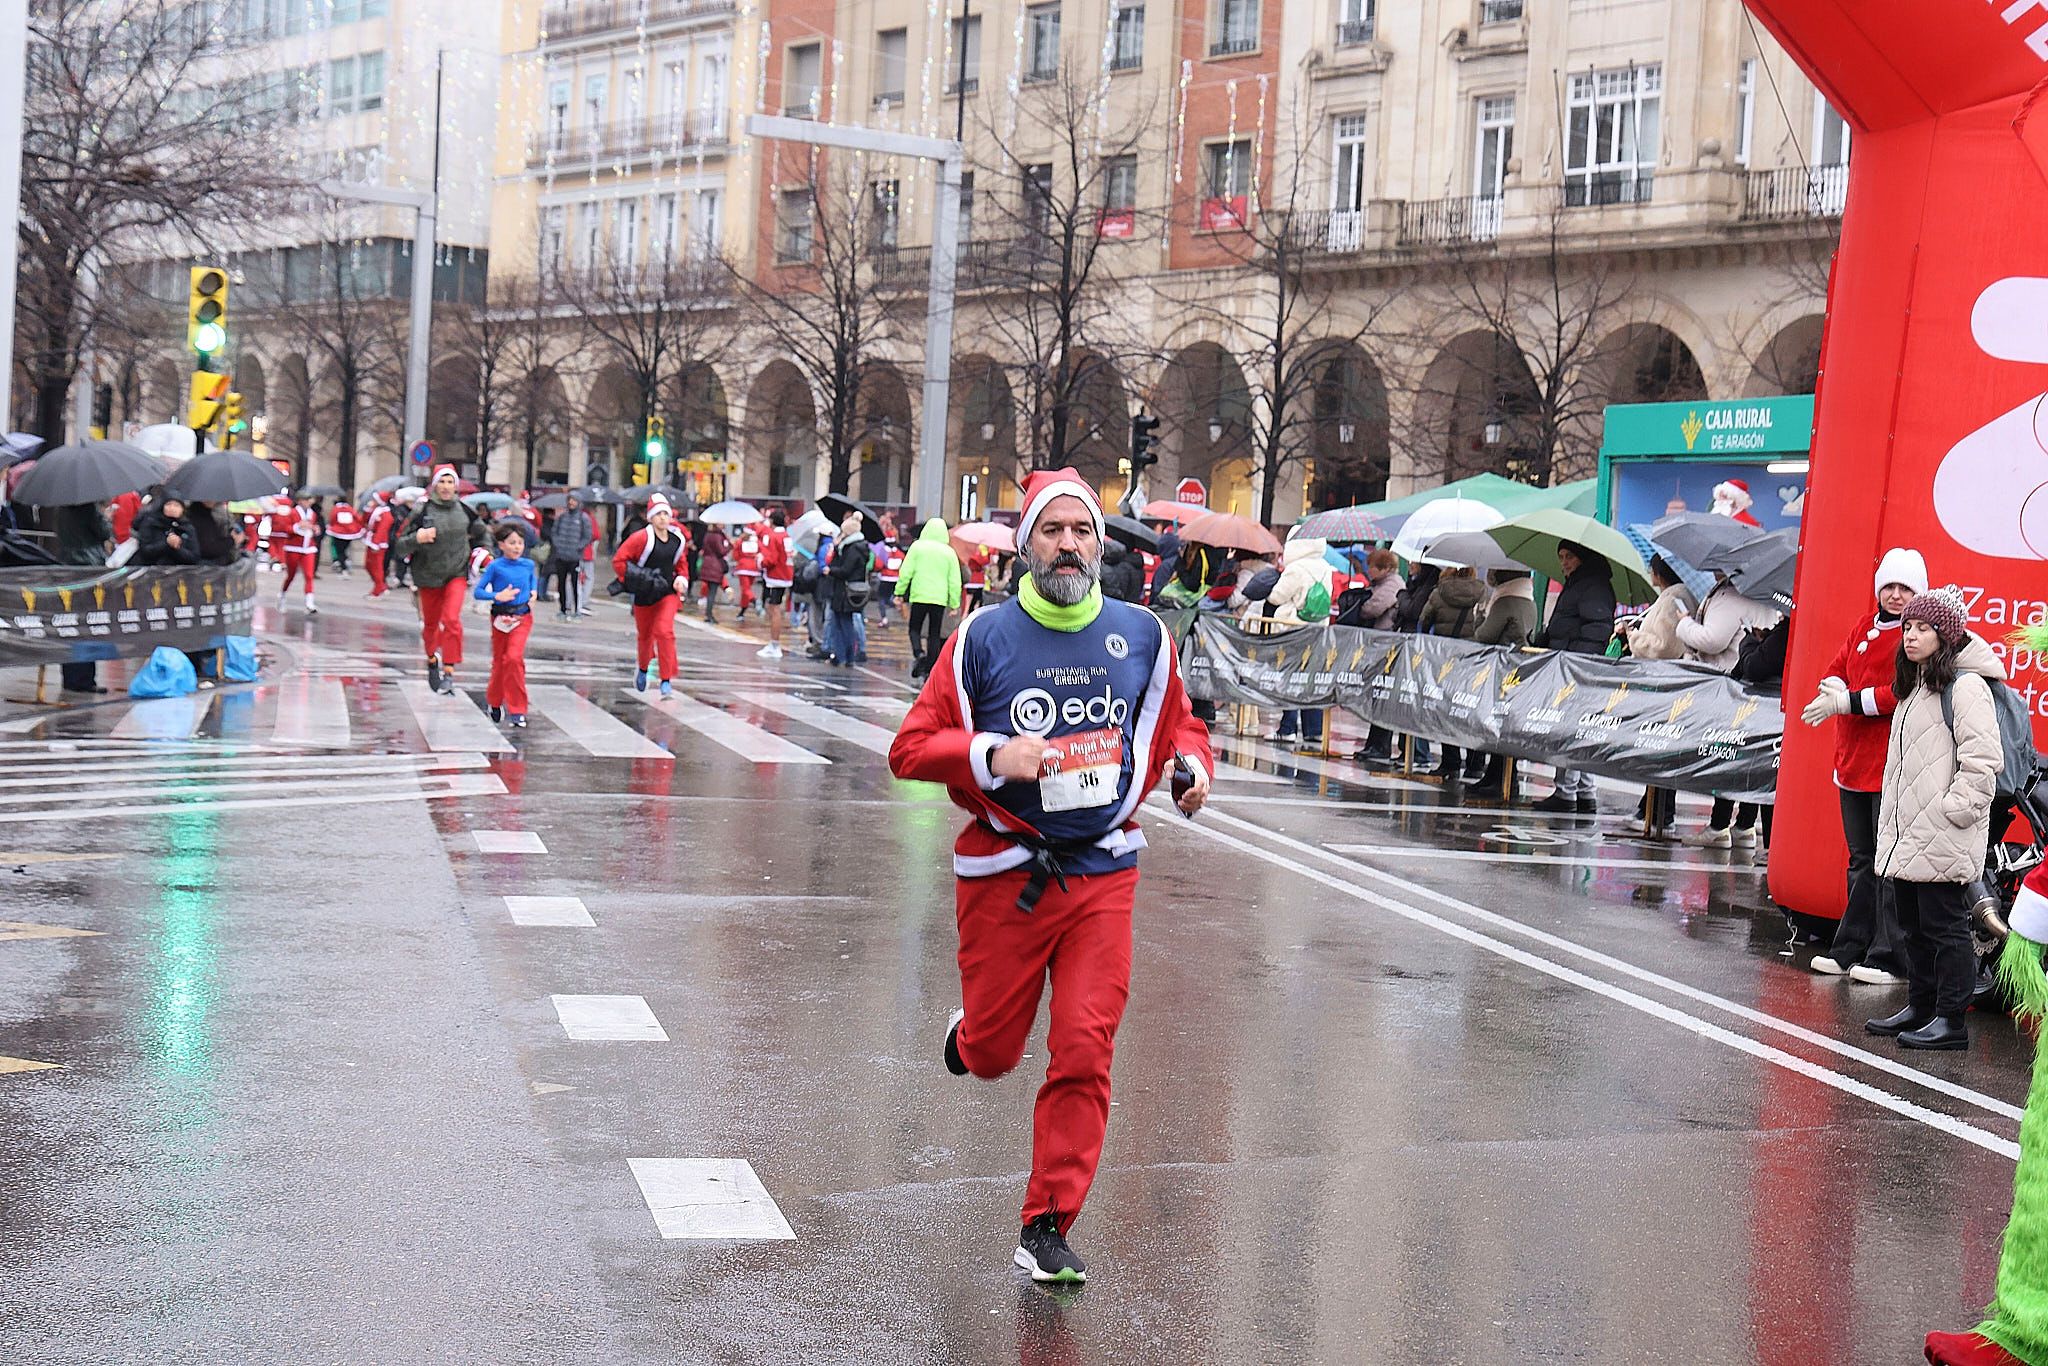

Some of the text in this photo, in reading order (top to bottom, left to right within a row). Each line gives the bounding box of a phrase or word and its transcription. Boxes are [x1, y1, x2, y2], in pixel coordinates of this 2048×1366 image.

[1705, 407, 1773, 430] CAJA RURAL
[1711, 430, 1765, 450] DE ARAGÓN
[1180, 491, 1203, 503] STOP
[1090, 665, 1109, 677] RUN
[1054, 674, 1091, 686] CIRCUITO
[1698, 743, 1737, 760] DE ARAGÓN
[1079, 770, 1099, 789] 36
